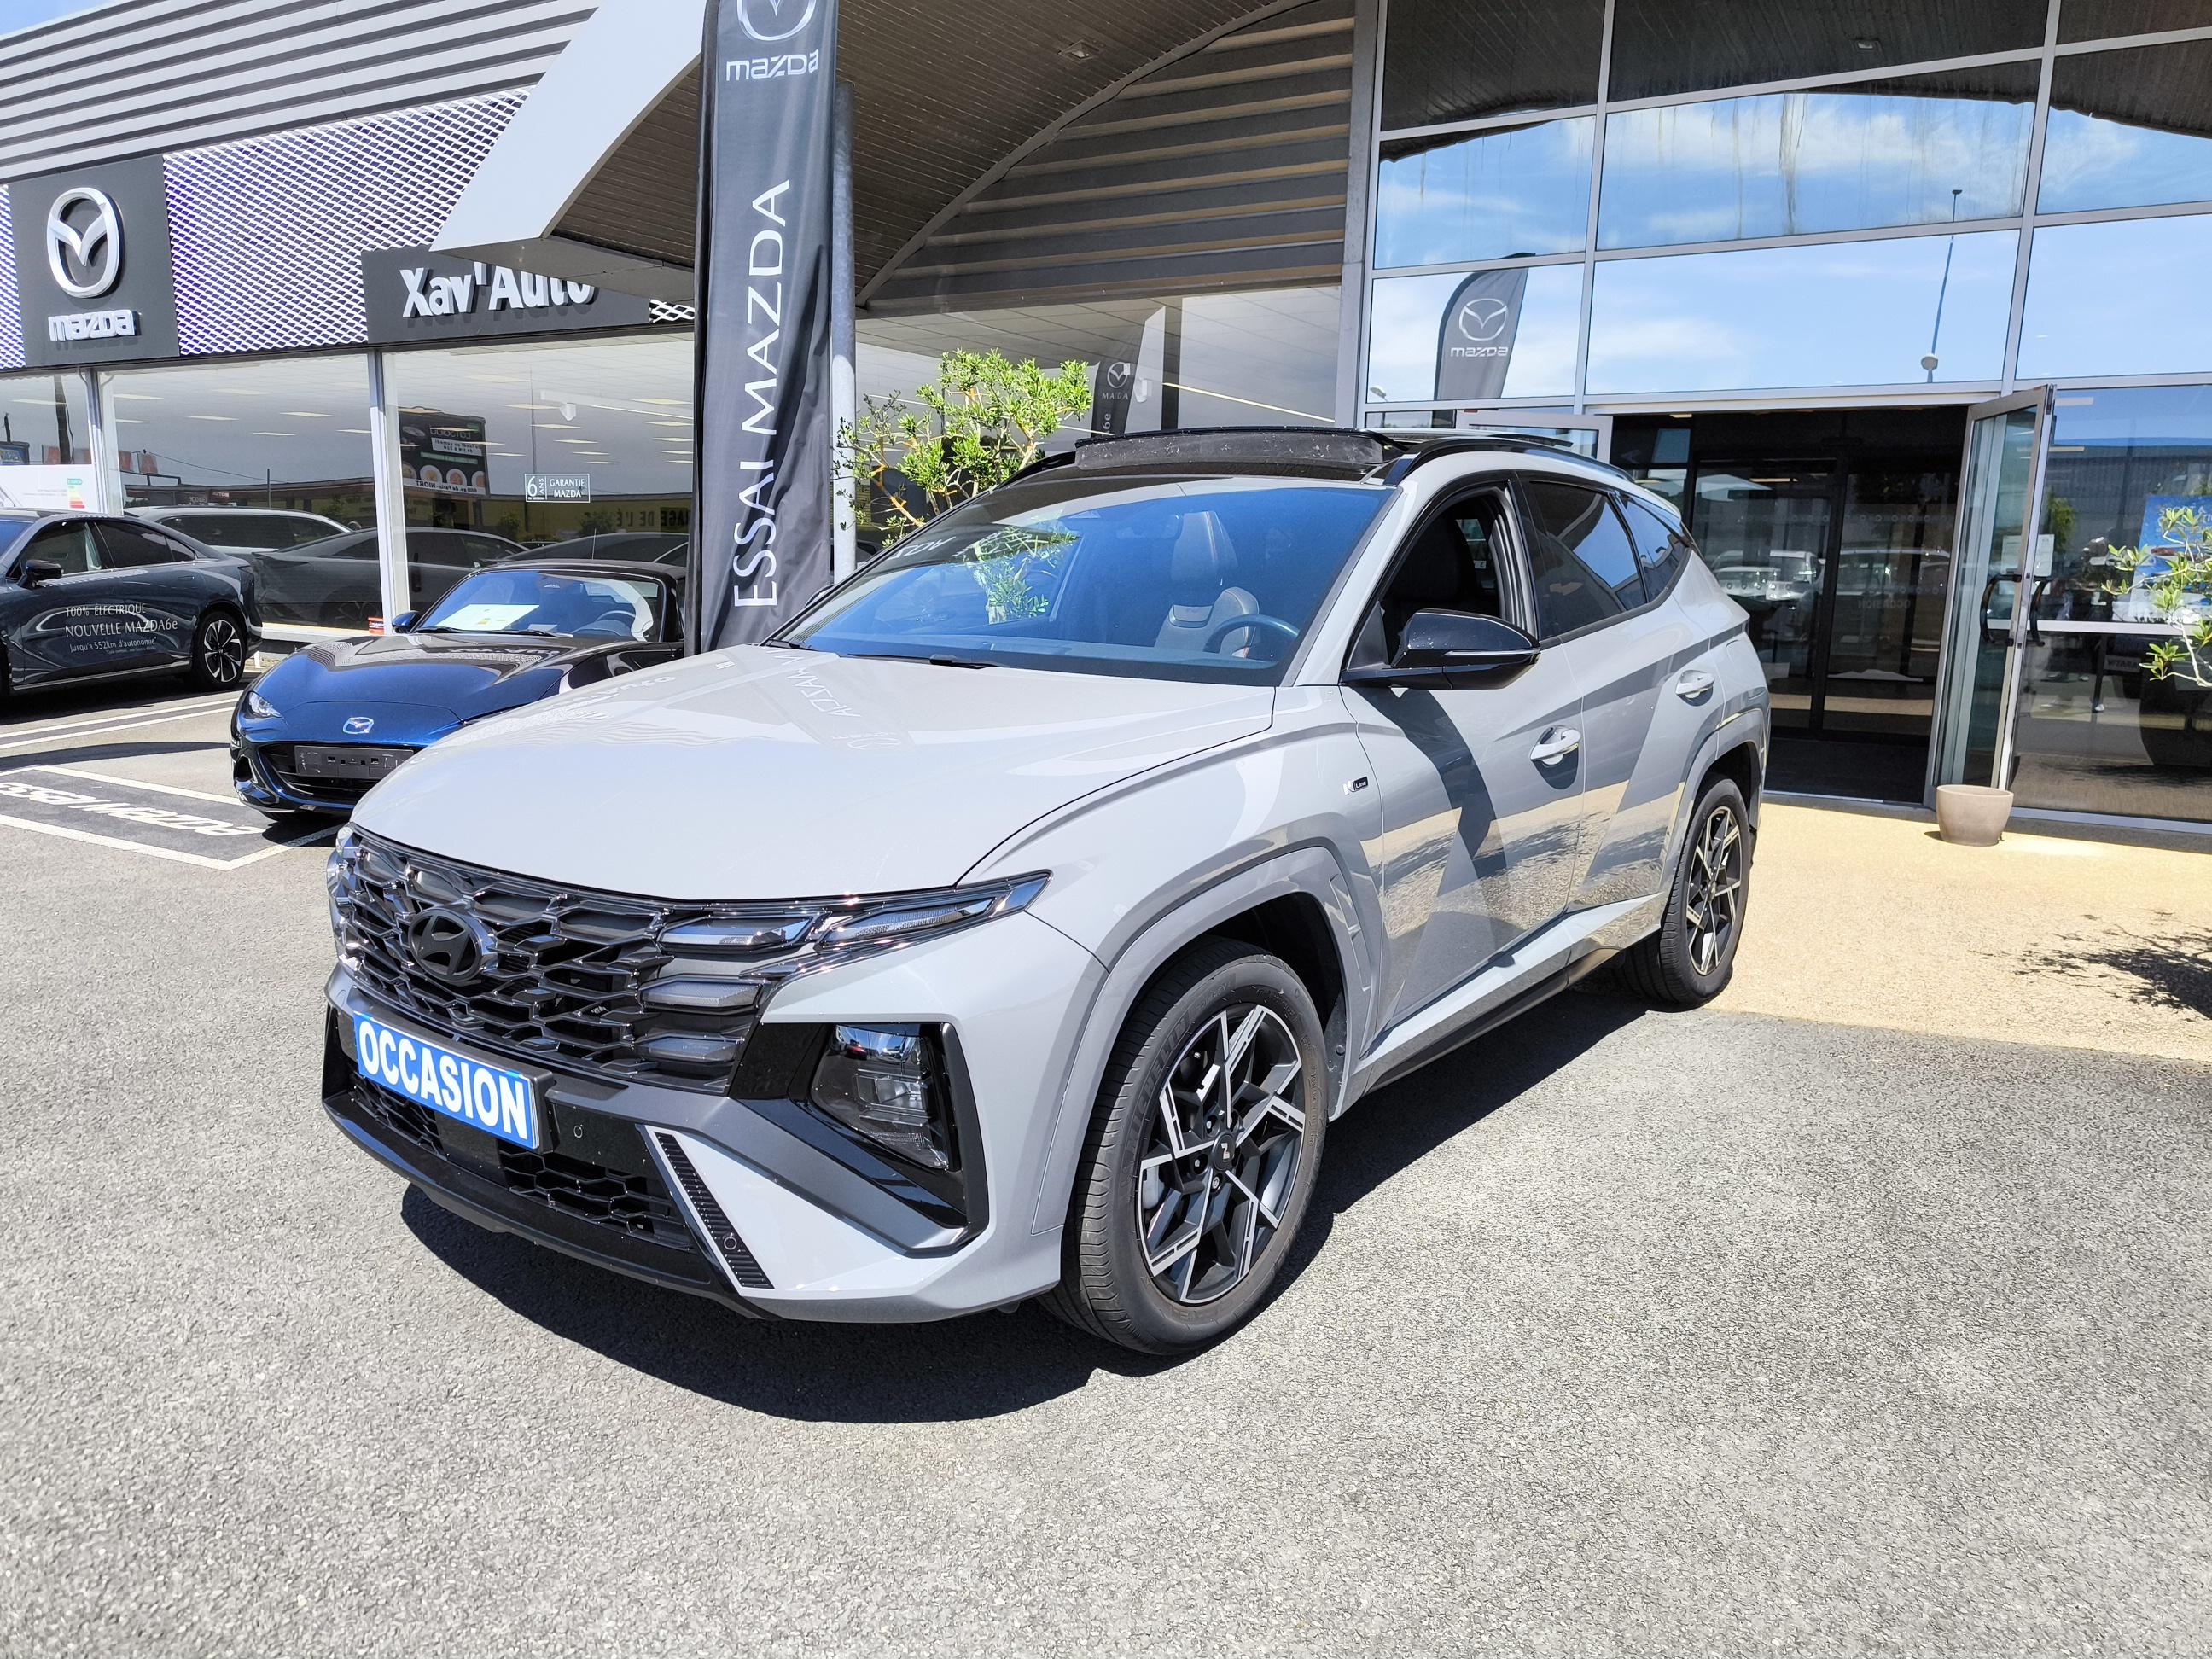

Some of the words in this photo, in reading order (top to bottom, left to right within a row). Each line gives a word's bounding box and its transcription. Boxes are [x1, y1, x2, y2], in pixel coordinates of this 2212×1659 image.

[726, 49, 819, 81] mazda
[742, 179, 790, 435] MAZDA
[48, 309, 136, 341] mazda
[1102, 392, 1129, 401] MADA
[527, 475, 538, 497] 6
[549, 478, 585, 487] GARANTIE
[553, 489, 582, 498] MAZDA
[733, 459, 777, 607] ESSAI
[65, 606, 90, 617] 100%
[94, 602, 147, 616] ÉLECTRIQUE
[65, 622, 122, 638] NOUVELLE
[125, 618, 178, 634] MAZDA6e
[95, 640, 117, 649] 552km
[359, 1021, 527, 1139] OCCASION
